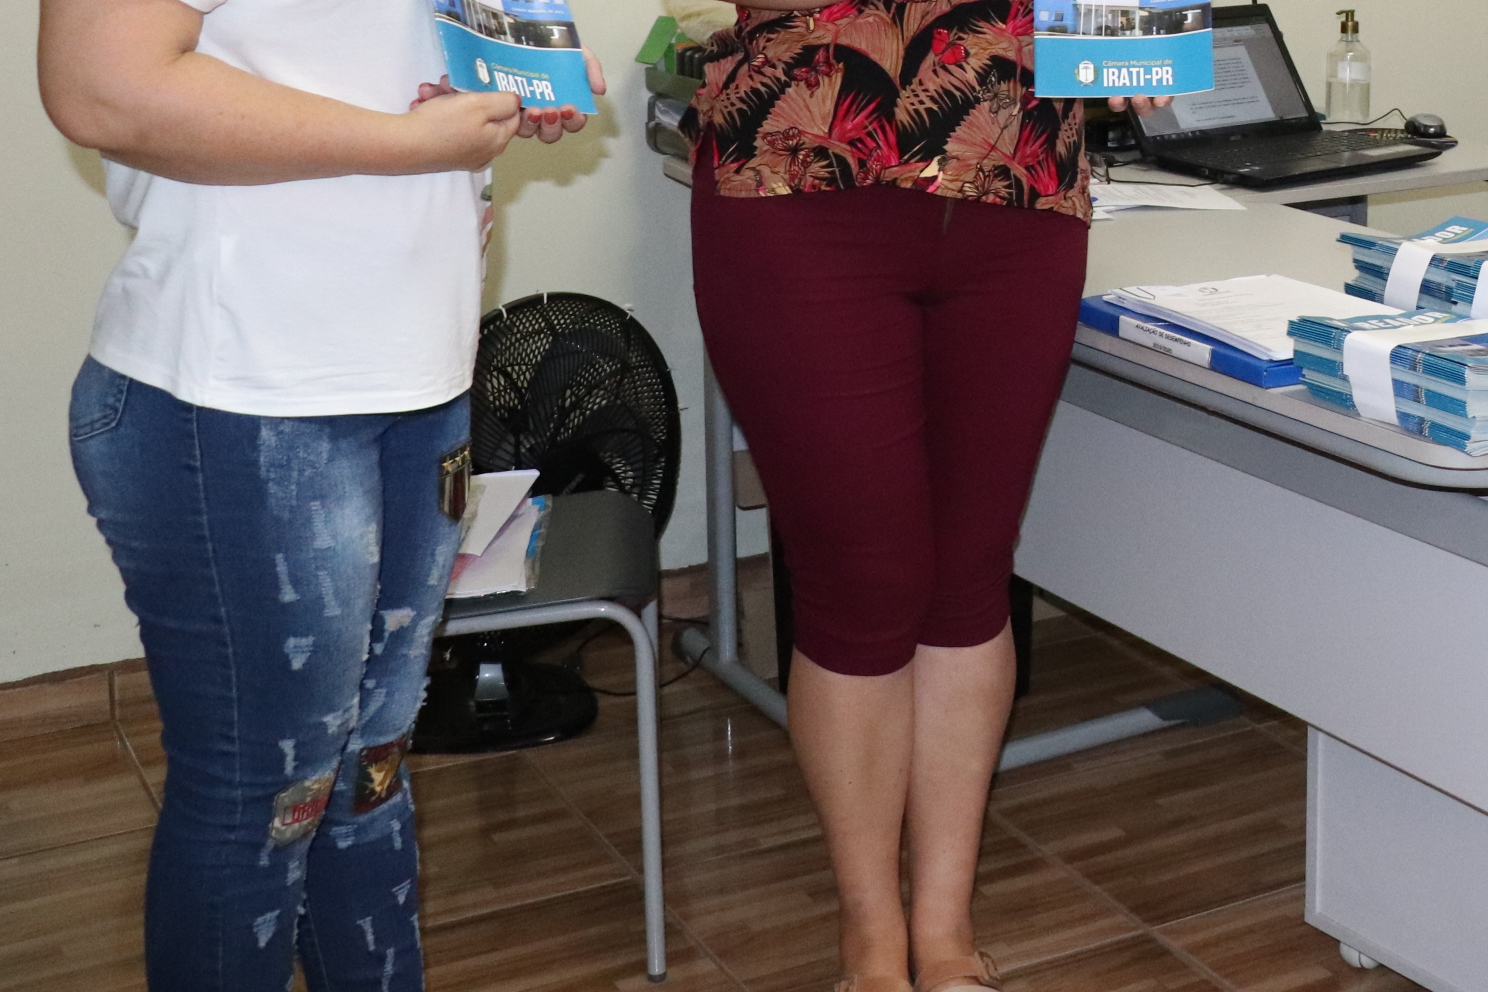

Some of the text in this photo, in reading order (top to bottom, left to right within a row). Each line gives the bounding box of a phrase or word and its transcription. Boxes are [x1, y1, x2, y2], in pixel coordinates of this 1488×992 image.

[494, 70, 556, 101] IRATI-PR
[1102, 66, 1174, 87] IRATI-PR
[1135, 323, 1158, 336] AVALIAÇÃO
[1164, 333, 1192, 348] DESEMPENHO
